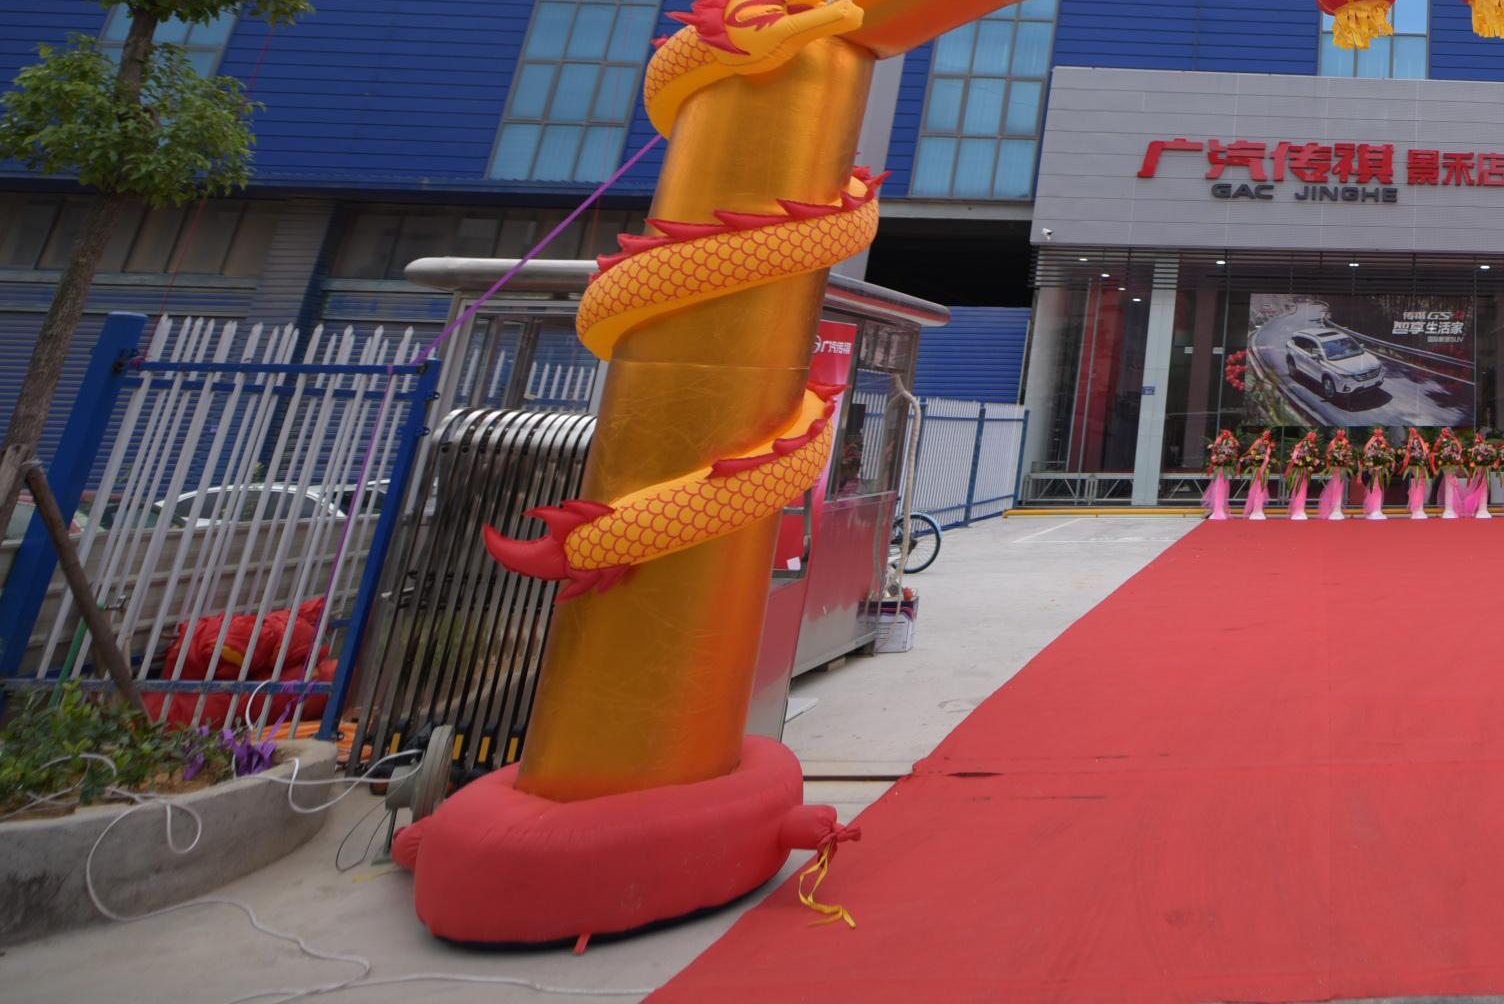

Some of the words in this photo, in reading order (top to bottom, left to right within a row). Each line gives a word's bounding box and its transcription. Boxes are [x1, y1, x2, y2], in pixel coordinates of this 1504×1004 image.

[1137, 138, 1394, 184] 广汽传祺
[1211, 183, 1275, 201] GAC
[1294, 184, 1398, 203] JINGHE
